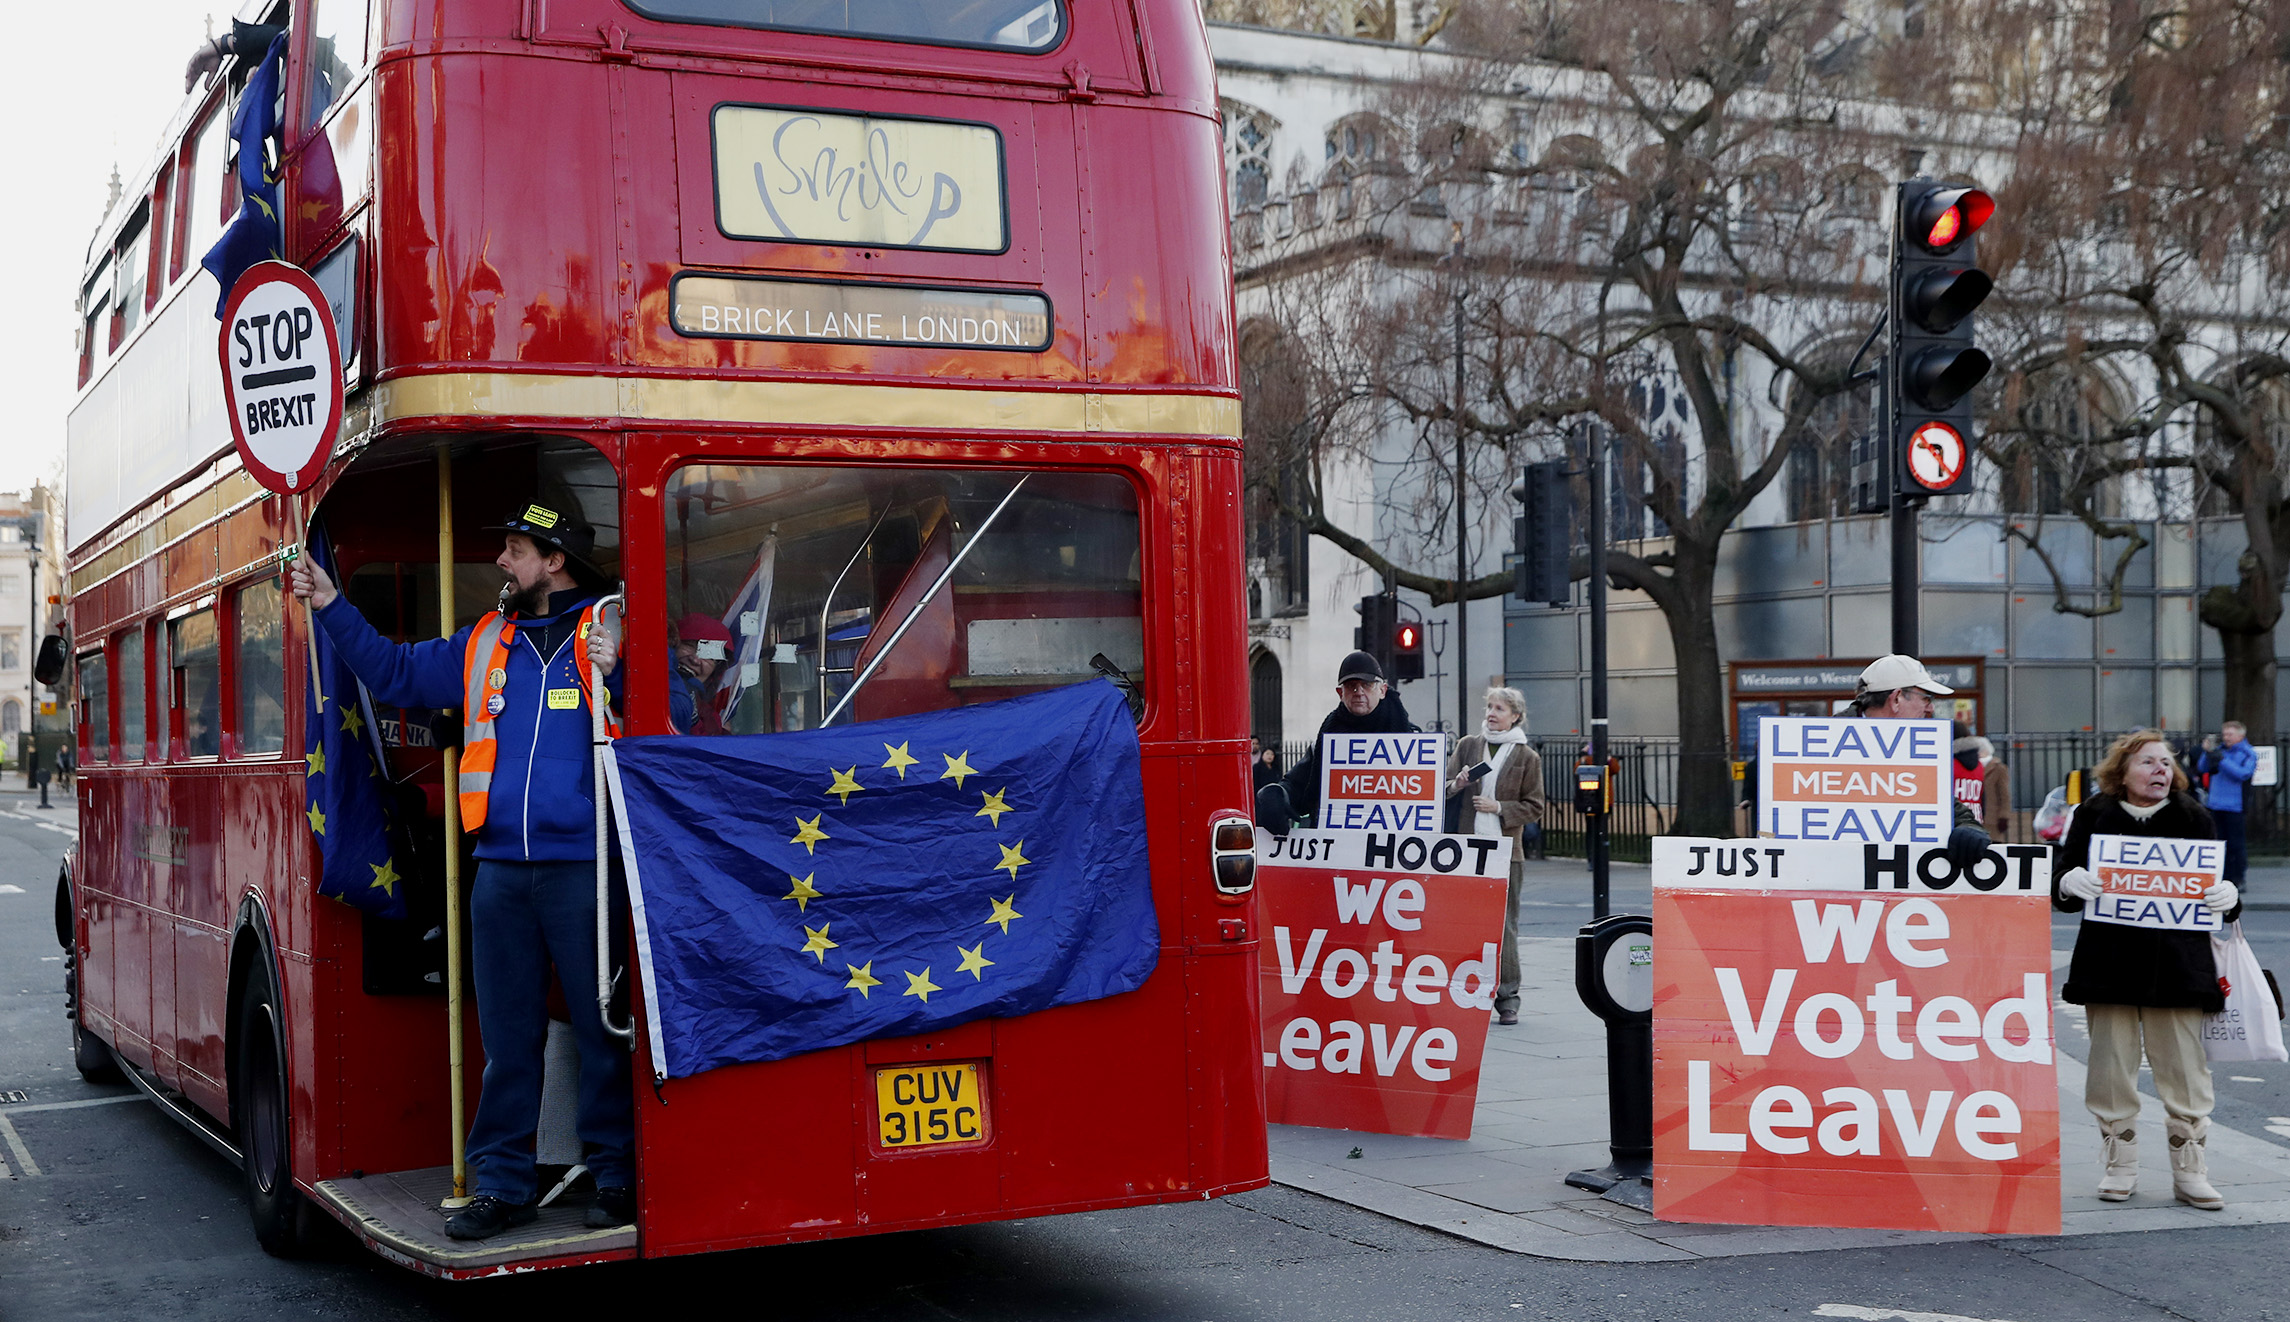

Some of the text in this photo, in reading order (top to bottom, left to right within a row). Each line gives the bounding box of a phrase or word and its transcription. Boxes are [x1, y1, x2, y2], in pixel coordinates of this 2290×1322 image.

[772, 115, 923, 223] Smile
[234, 306, 312, 368] STOP
[701, 305, 795, 336] BRICK
[246, 393, 316, 435] BREXIT
[1741, 674, 1800, 686] Welcome
[1803, 674, 1818, 685] to
[1330, 738, 1437, 766] LEAVE
[1772, 724, 1938, 760] LEAVE
[1341, 774, 1423, 796] MEANS
[1792, 770, 1918, 797] MEANS
[1326, 803, 1433, 832] LEAVE
[1772, 807, 1938, 843] LEAVE
[1268, 832, 1498, 875] JUST HOOT
[1687, 843, 2048, 891] JUST HOOT
[2098, 839, 2217, 869] LEAVE
[2110, 872, 2203, 895] MEANS
[1333, 876, 1426, 931] we
[2094, 898, 2214, 926] LEAVE
[1791, 898, 1950, 968] we
[1273, 925, 1498, 1011] Voted
[1713, 967, 2053, 1065] Voted
[2204, 1026, 2247, 1041] Leave
[893, 1069, 962, 1105] CUV
[884, 1106, 977, 1144] 315C
[1688, 1060, 2023, 1161] Leave
